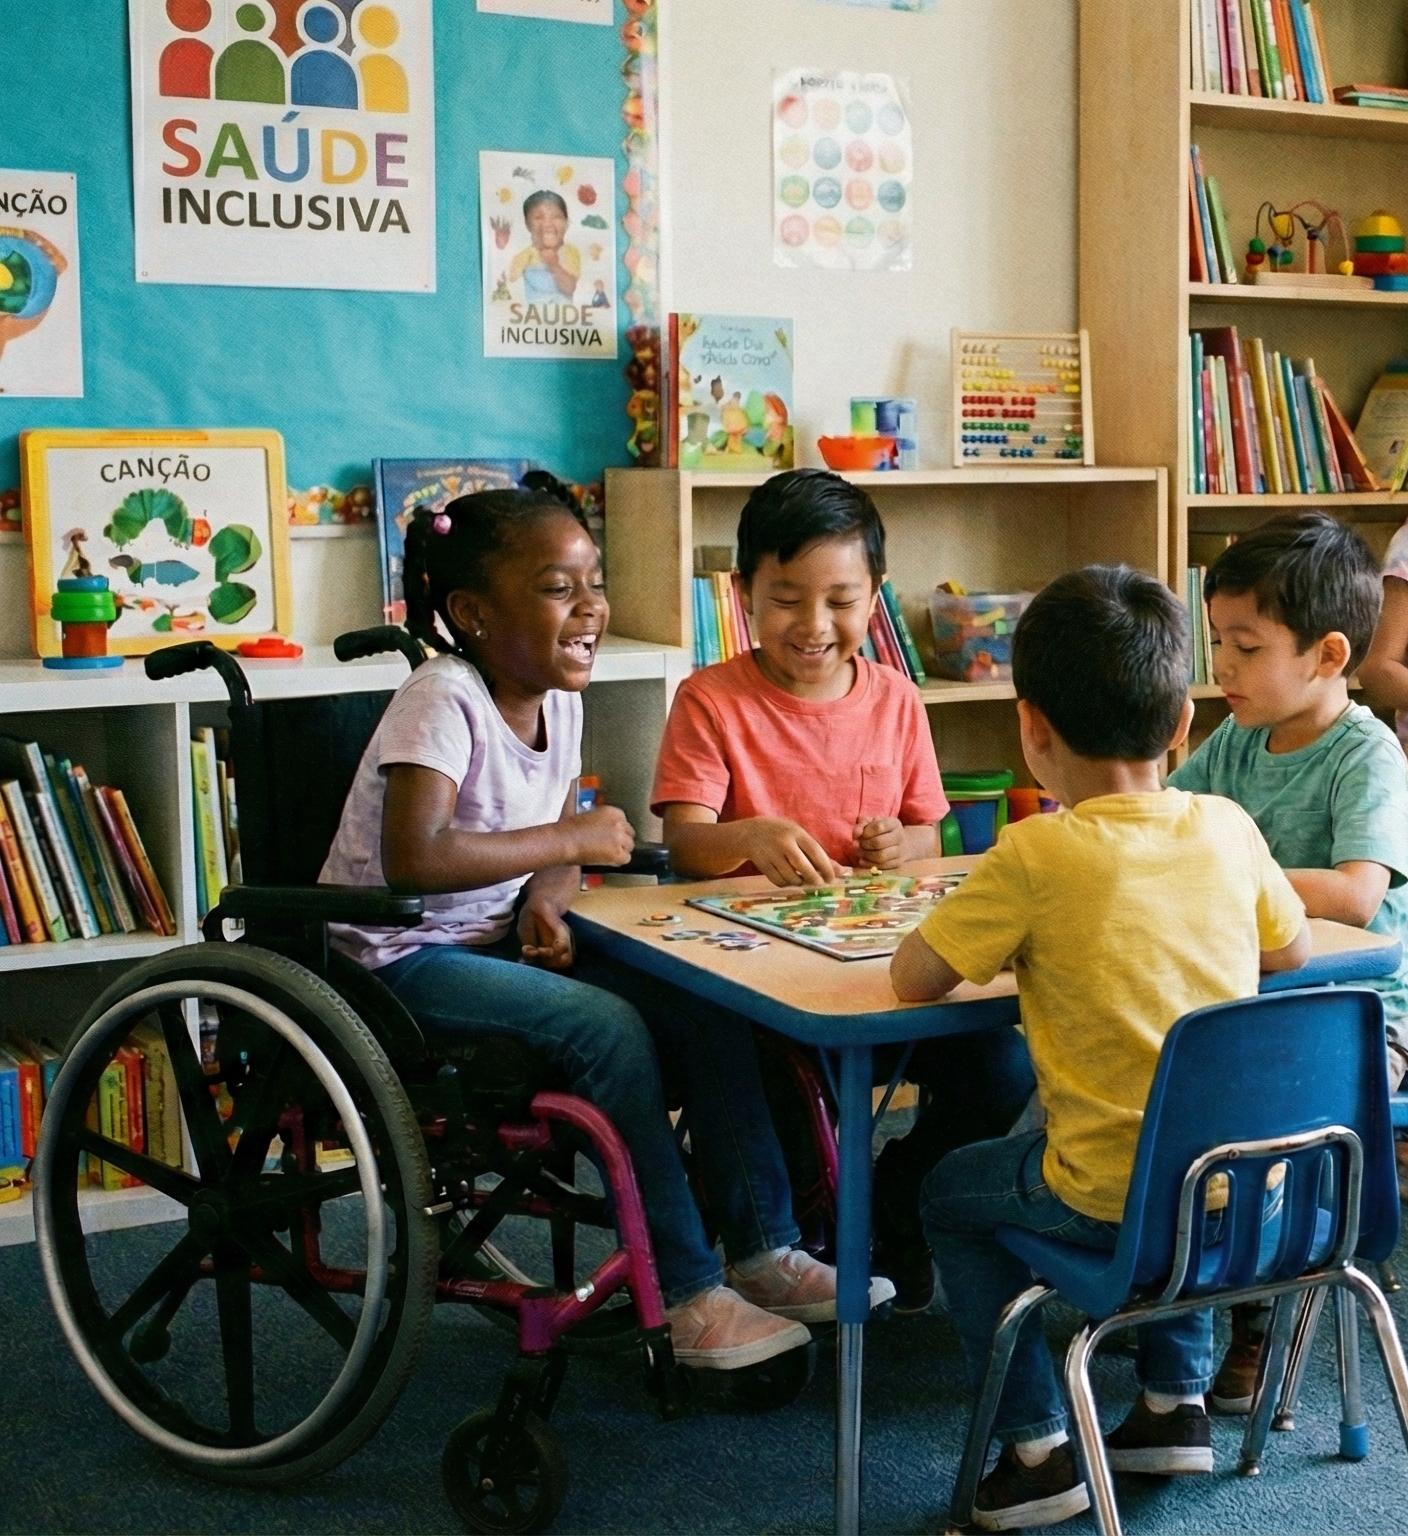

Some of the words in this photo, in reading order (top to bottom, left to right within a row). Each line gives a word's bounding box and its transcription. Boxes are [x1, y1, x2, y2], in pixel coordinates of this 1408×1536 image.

[162, 110, 408, 187] SAÚDE
[162, 187, 410, 233] INCLUSIVA
[509, 299, 594, 326] SAÚDE
[100, 453, 211, 484] CANÇÃO
